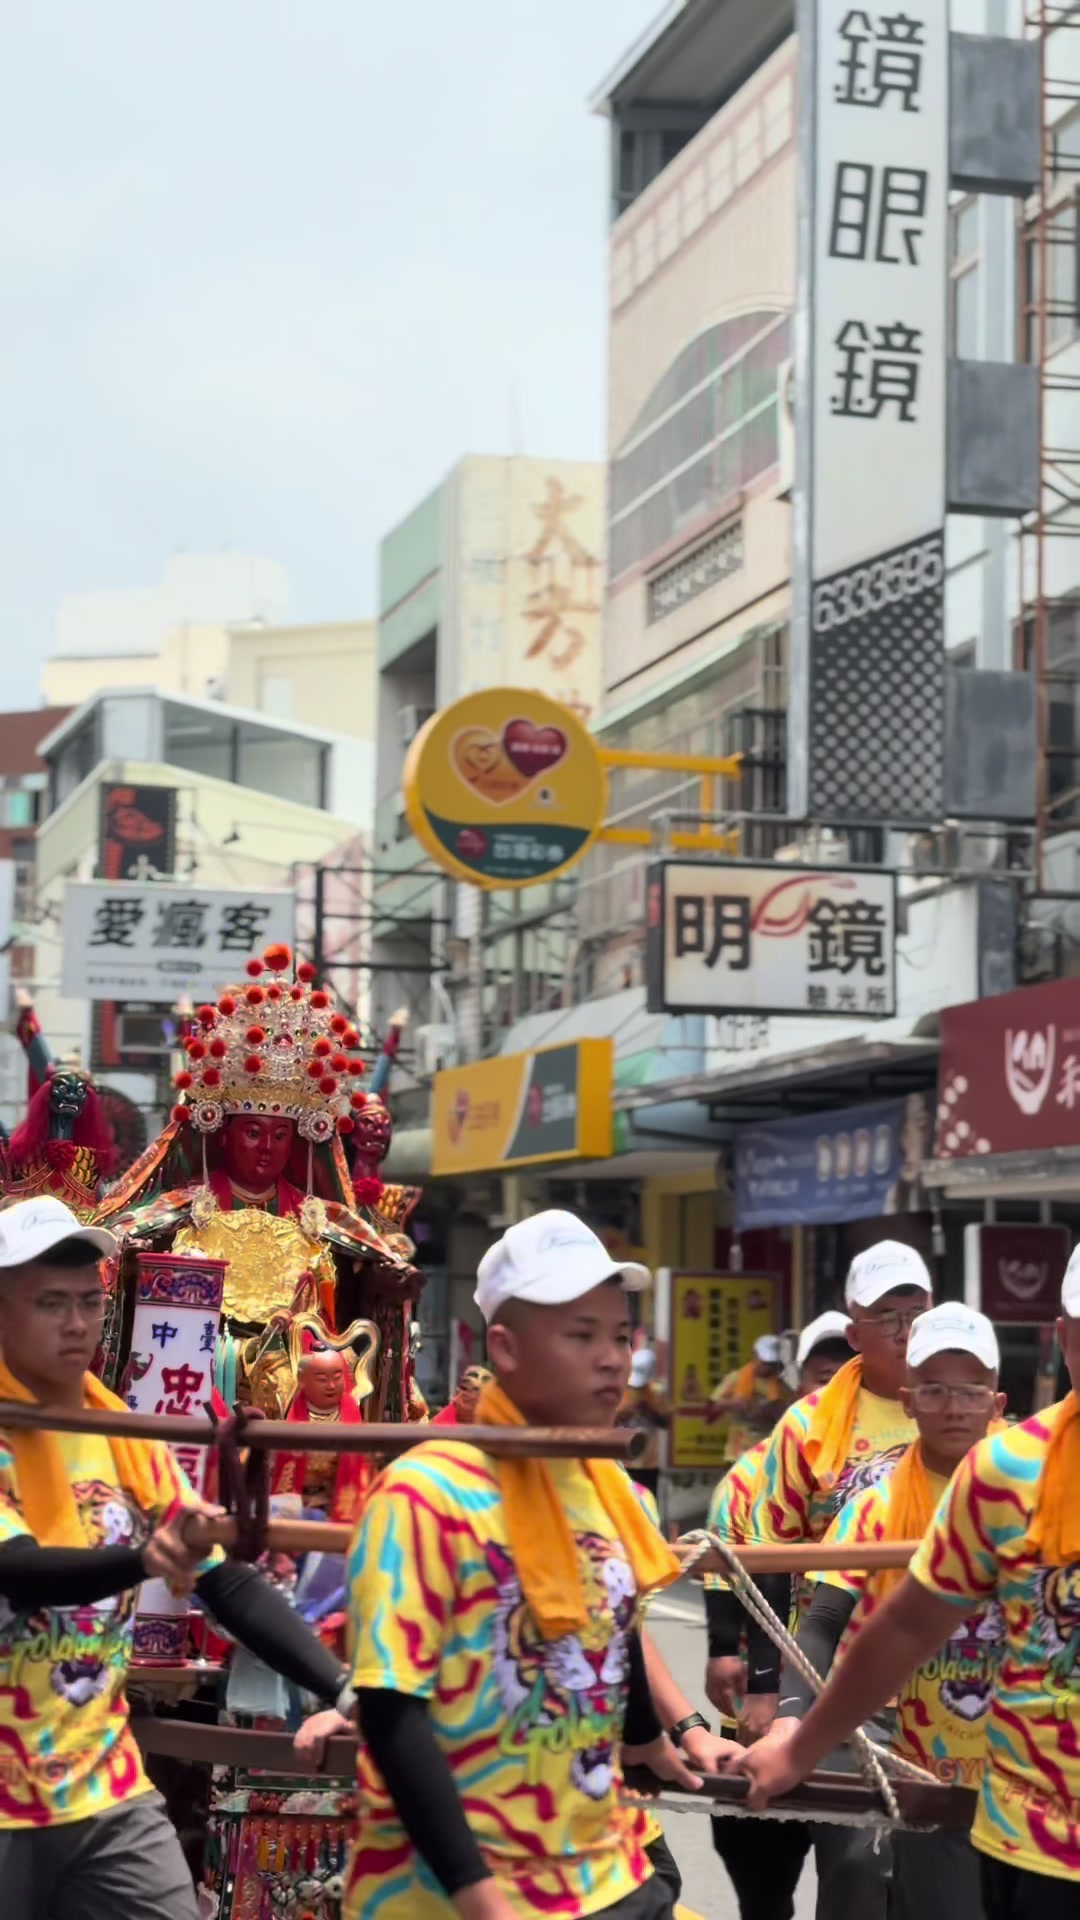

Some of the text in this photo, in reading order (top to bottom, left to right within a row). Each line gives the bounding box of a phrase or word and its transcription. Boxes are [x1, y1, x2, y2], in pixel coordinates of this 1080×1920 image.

[828, 10, 928, 422] 鏡眼鏡
[88, 898, 271, 952] 愛瘋客
[674, 895, 887, 977] 明鏡
